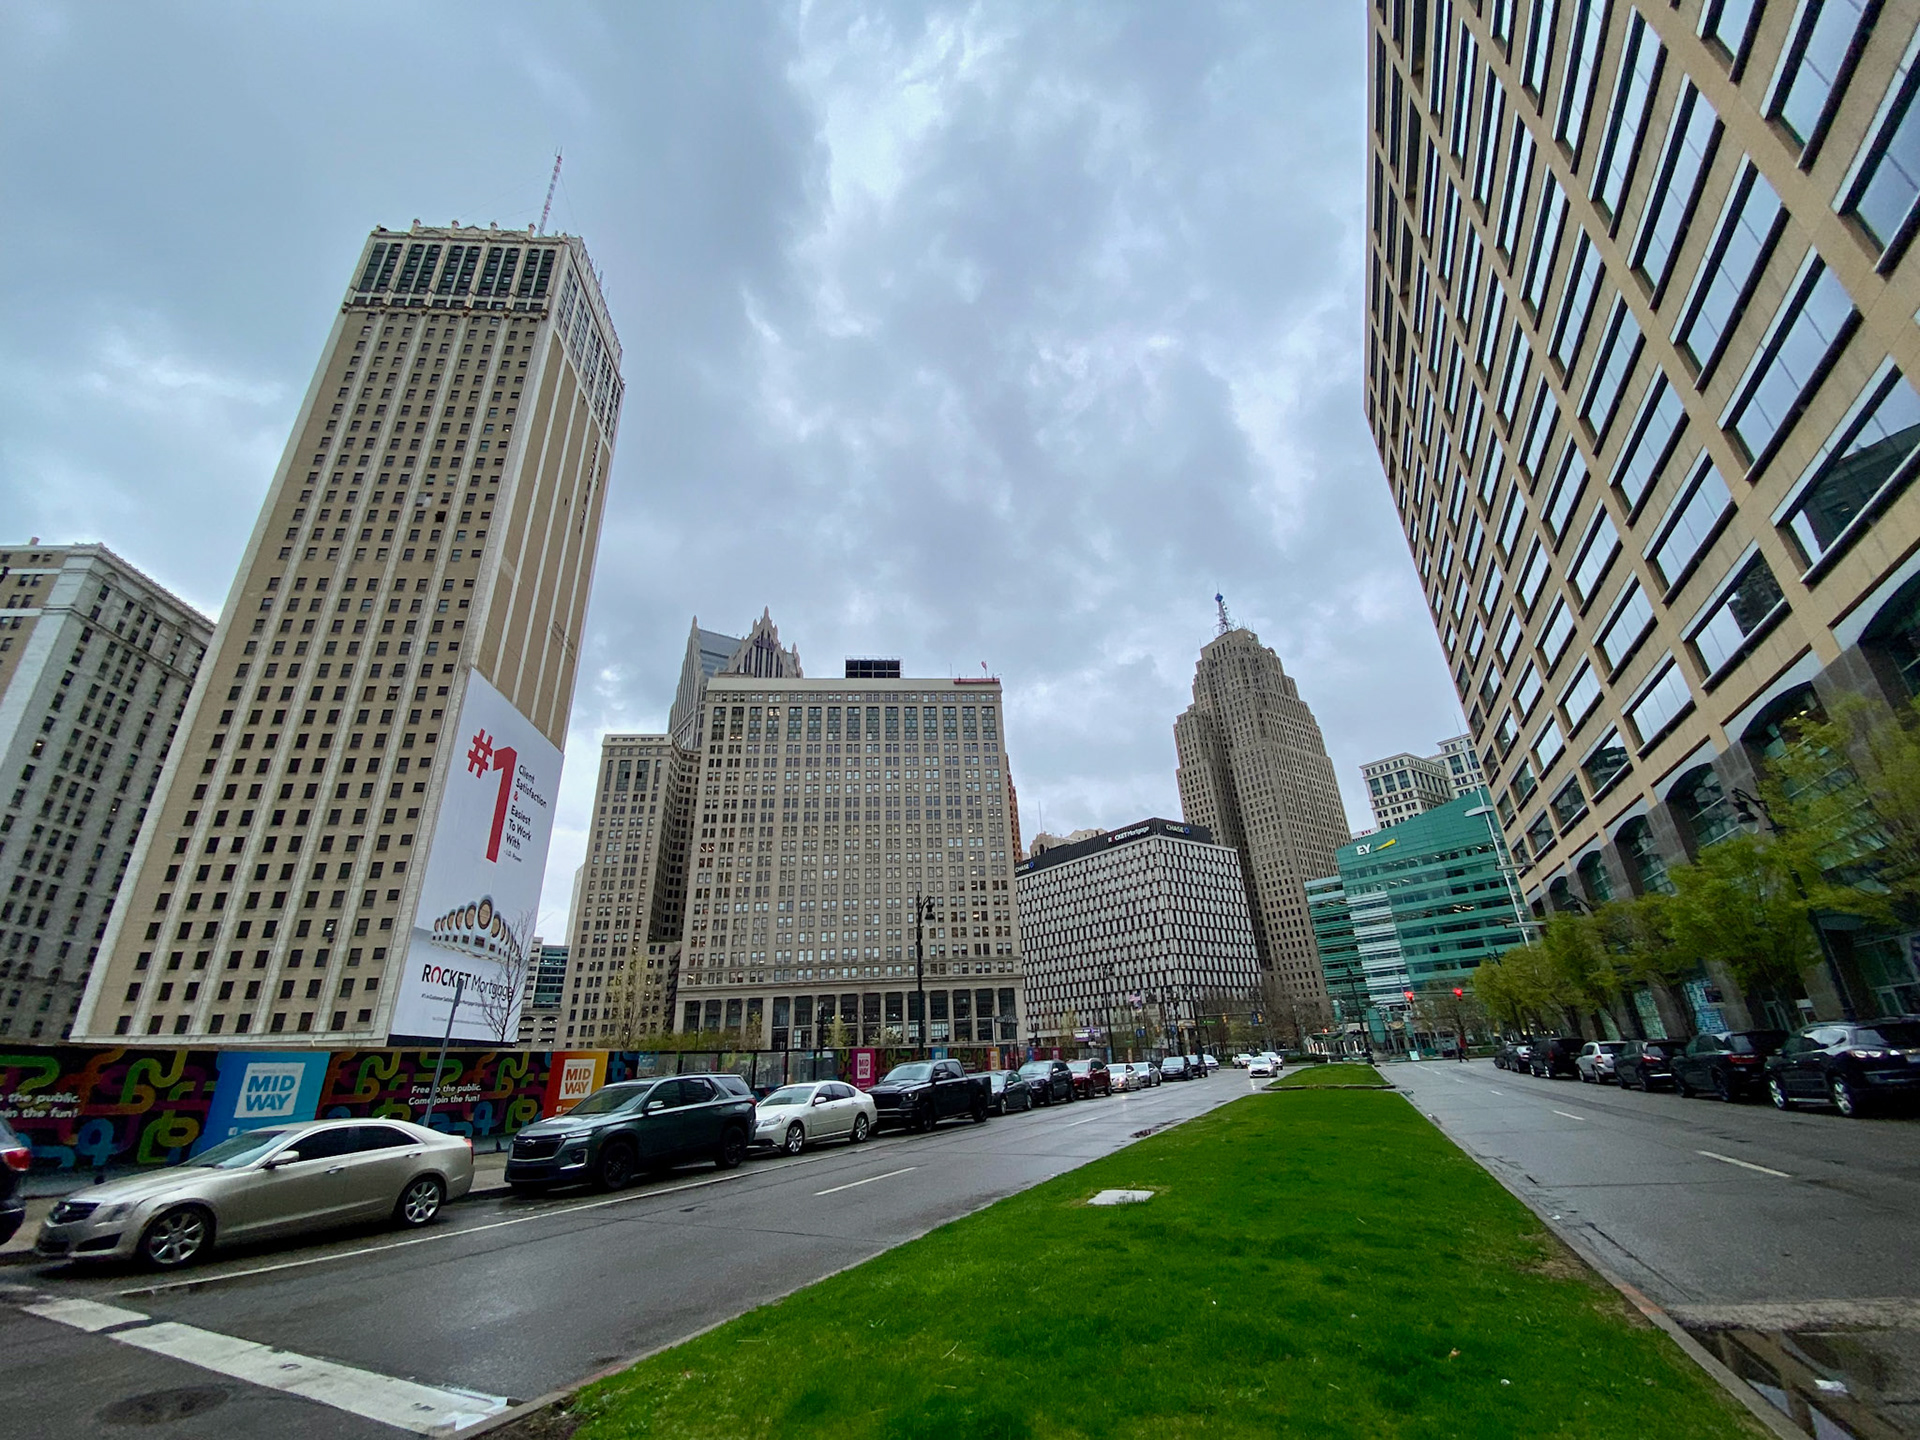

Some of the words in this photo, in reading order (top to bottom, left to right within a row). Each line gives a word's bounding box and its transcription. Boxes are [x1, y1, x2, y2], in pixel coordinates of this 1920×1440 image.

[518, 764, 535, 784] Client
[467, 728, 517, 863] #1
[513, 791, 518, 801] &
[515, 778, 547, 808] Satisfaction
[511, 805, 531, 826] Easiest
[509, 818, 516, 832] To
[516, 823, 532, 842] Work
[1166, 824, 1184, 833] CHASE
[506, 833, 521, 851] With
[1356, 843, 1370, 856] EY
[565, 1068, 591, 1081] MID
[247, 1075, 296, 1092] MID
[411, 1085, 430, 1094] Free
[443, 1084, 456, 1092] the
[457, 1083, 481, 1093] public.
[565, 1081, 589, 1095] WAY
[246, 1093, 292, 1111] WAY
[433, 1095, 449, 1106] join
[450, 1094, 463, 1103] the
[465, 1094, 480, 1103] fun!
[22, 1107, 46, 1118] the
[50, 1106, 79, 1118] fun!
